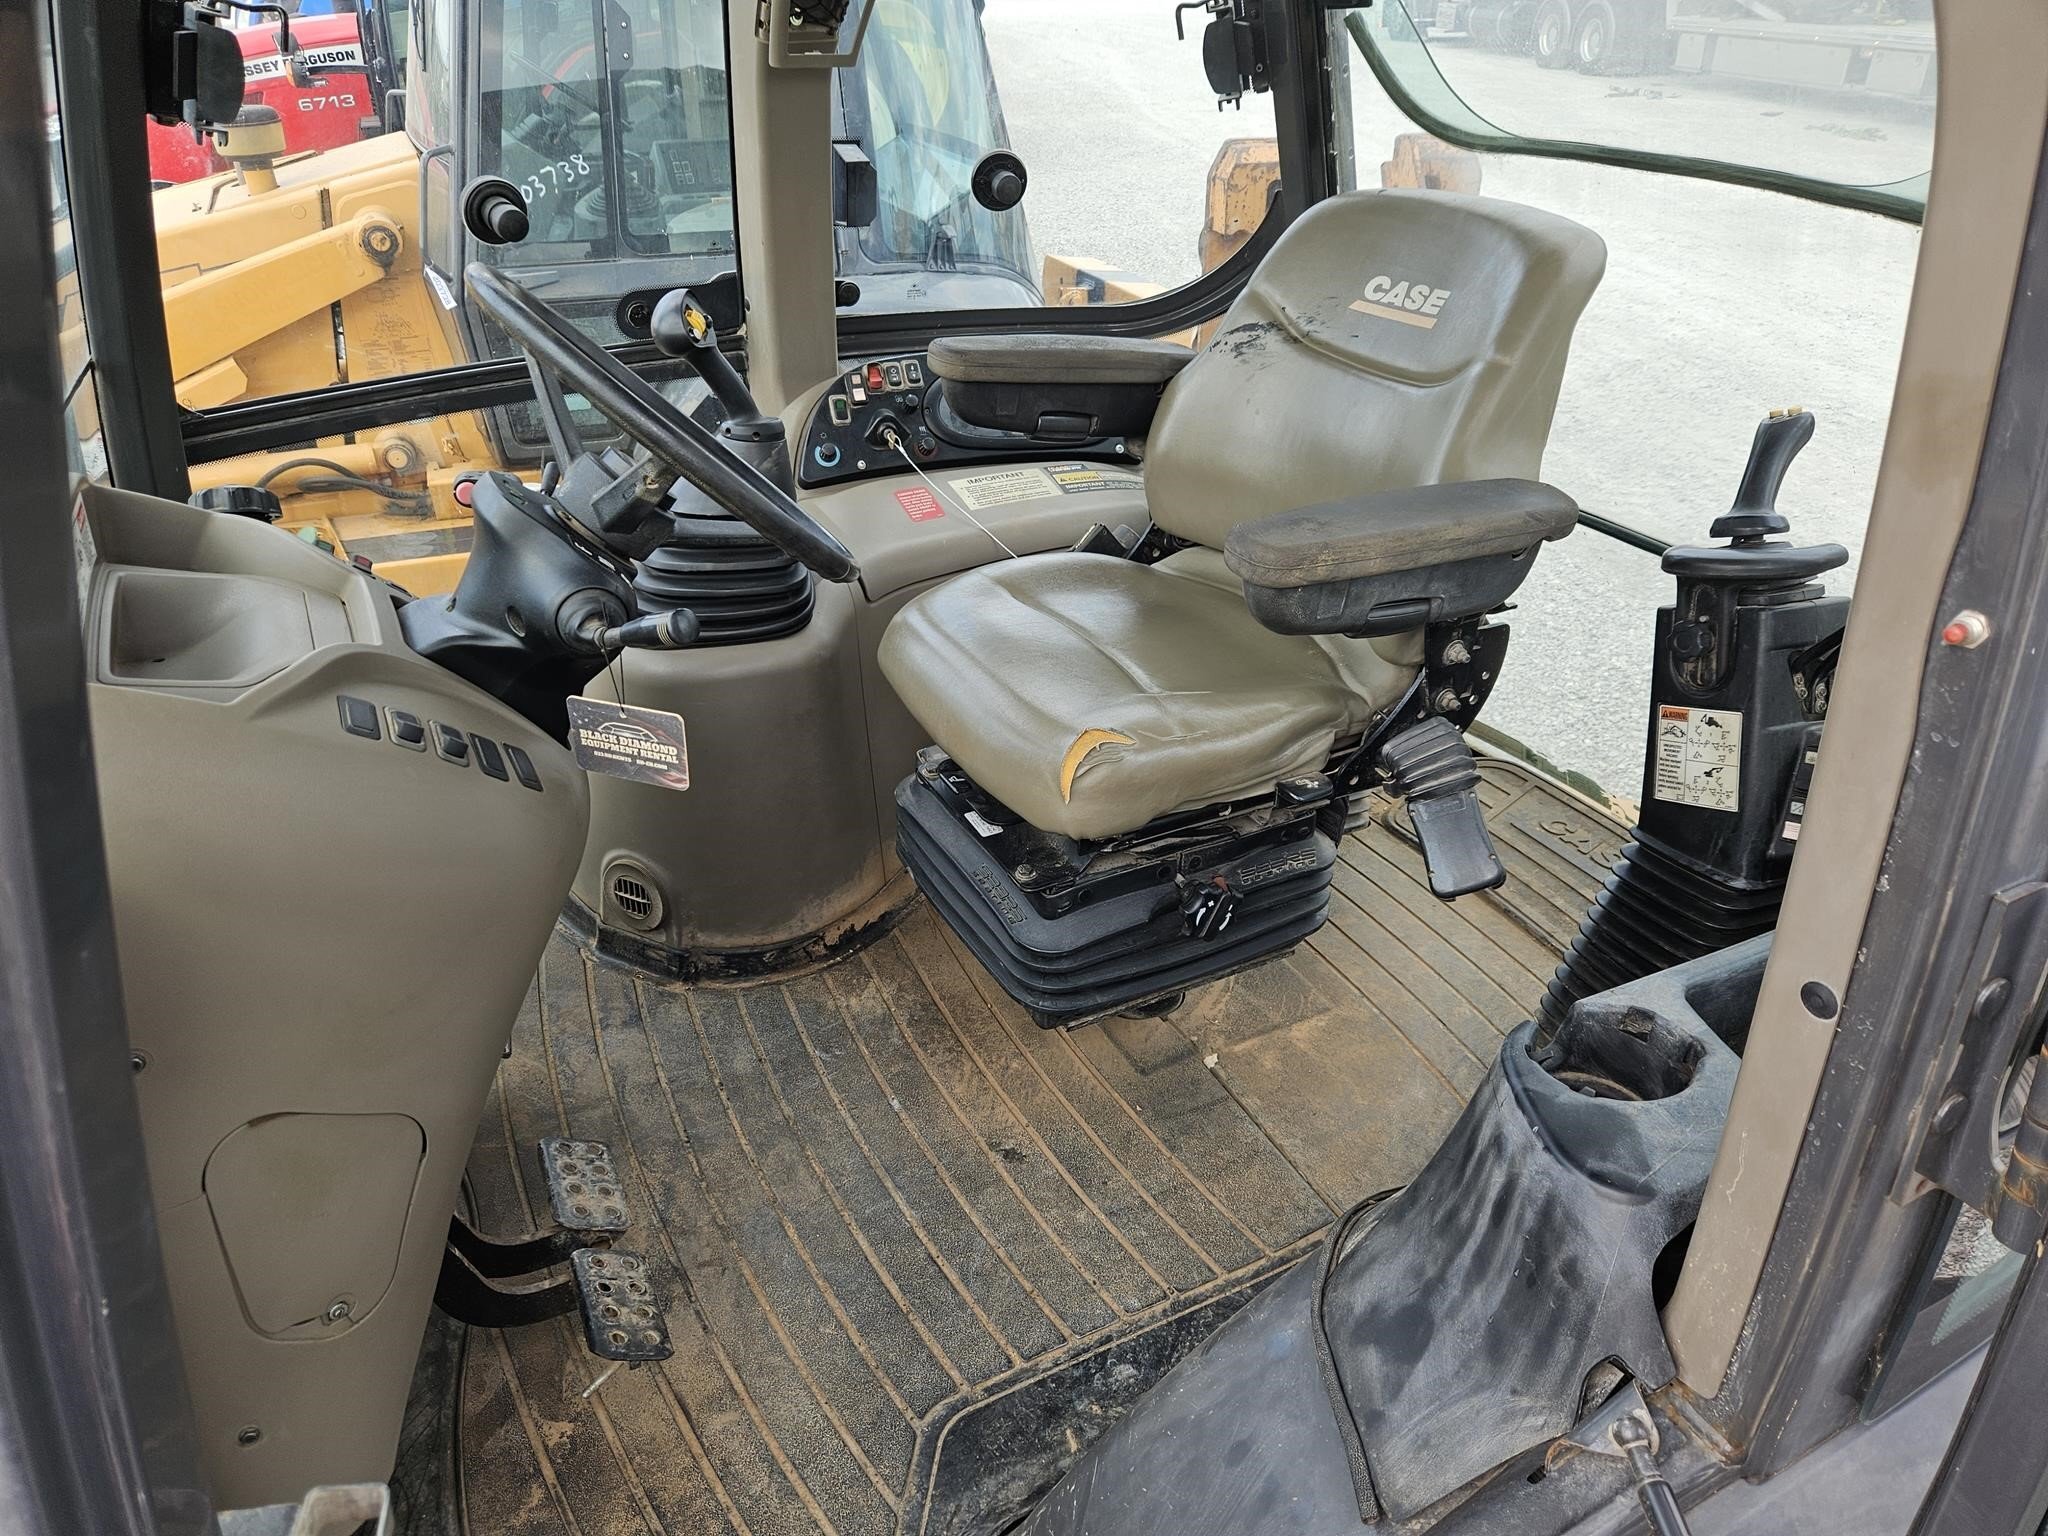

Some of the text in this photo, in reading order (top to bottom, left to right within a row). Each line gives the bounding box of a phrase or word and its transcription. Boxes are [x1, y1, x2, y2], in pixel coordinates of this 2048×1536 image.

[244, 60, 279, 77] SSEY
[298, 94, 356, 112] 6713
[1364, 275, 1451, 315] CASE
[967, 471, 1025, 485] IMPORTANT
[1065, 481, 1105, 489] IMPORTANT
[579, 729, 678, 756] BLACK DIAMOND
[580, 738, 679, 764] EQUIPMENT RENTAL
[1538, 820, 1622, 870] CAS
